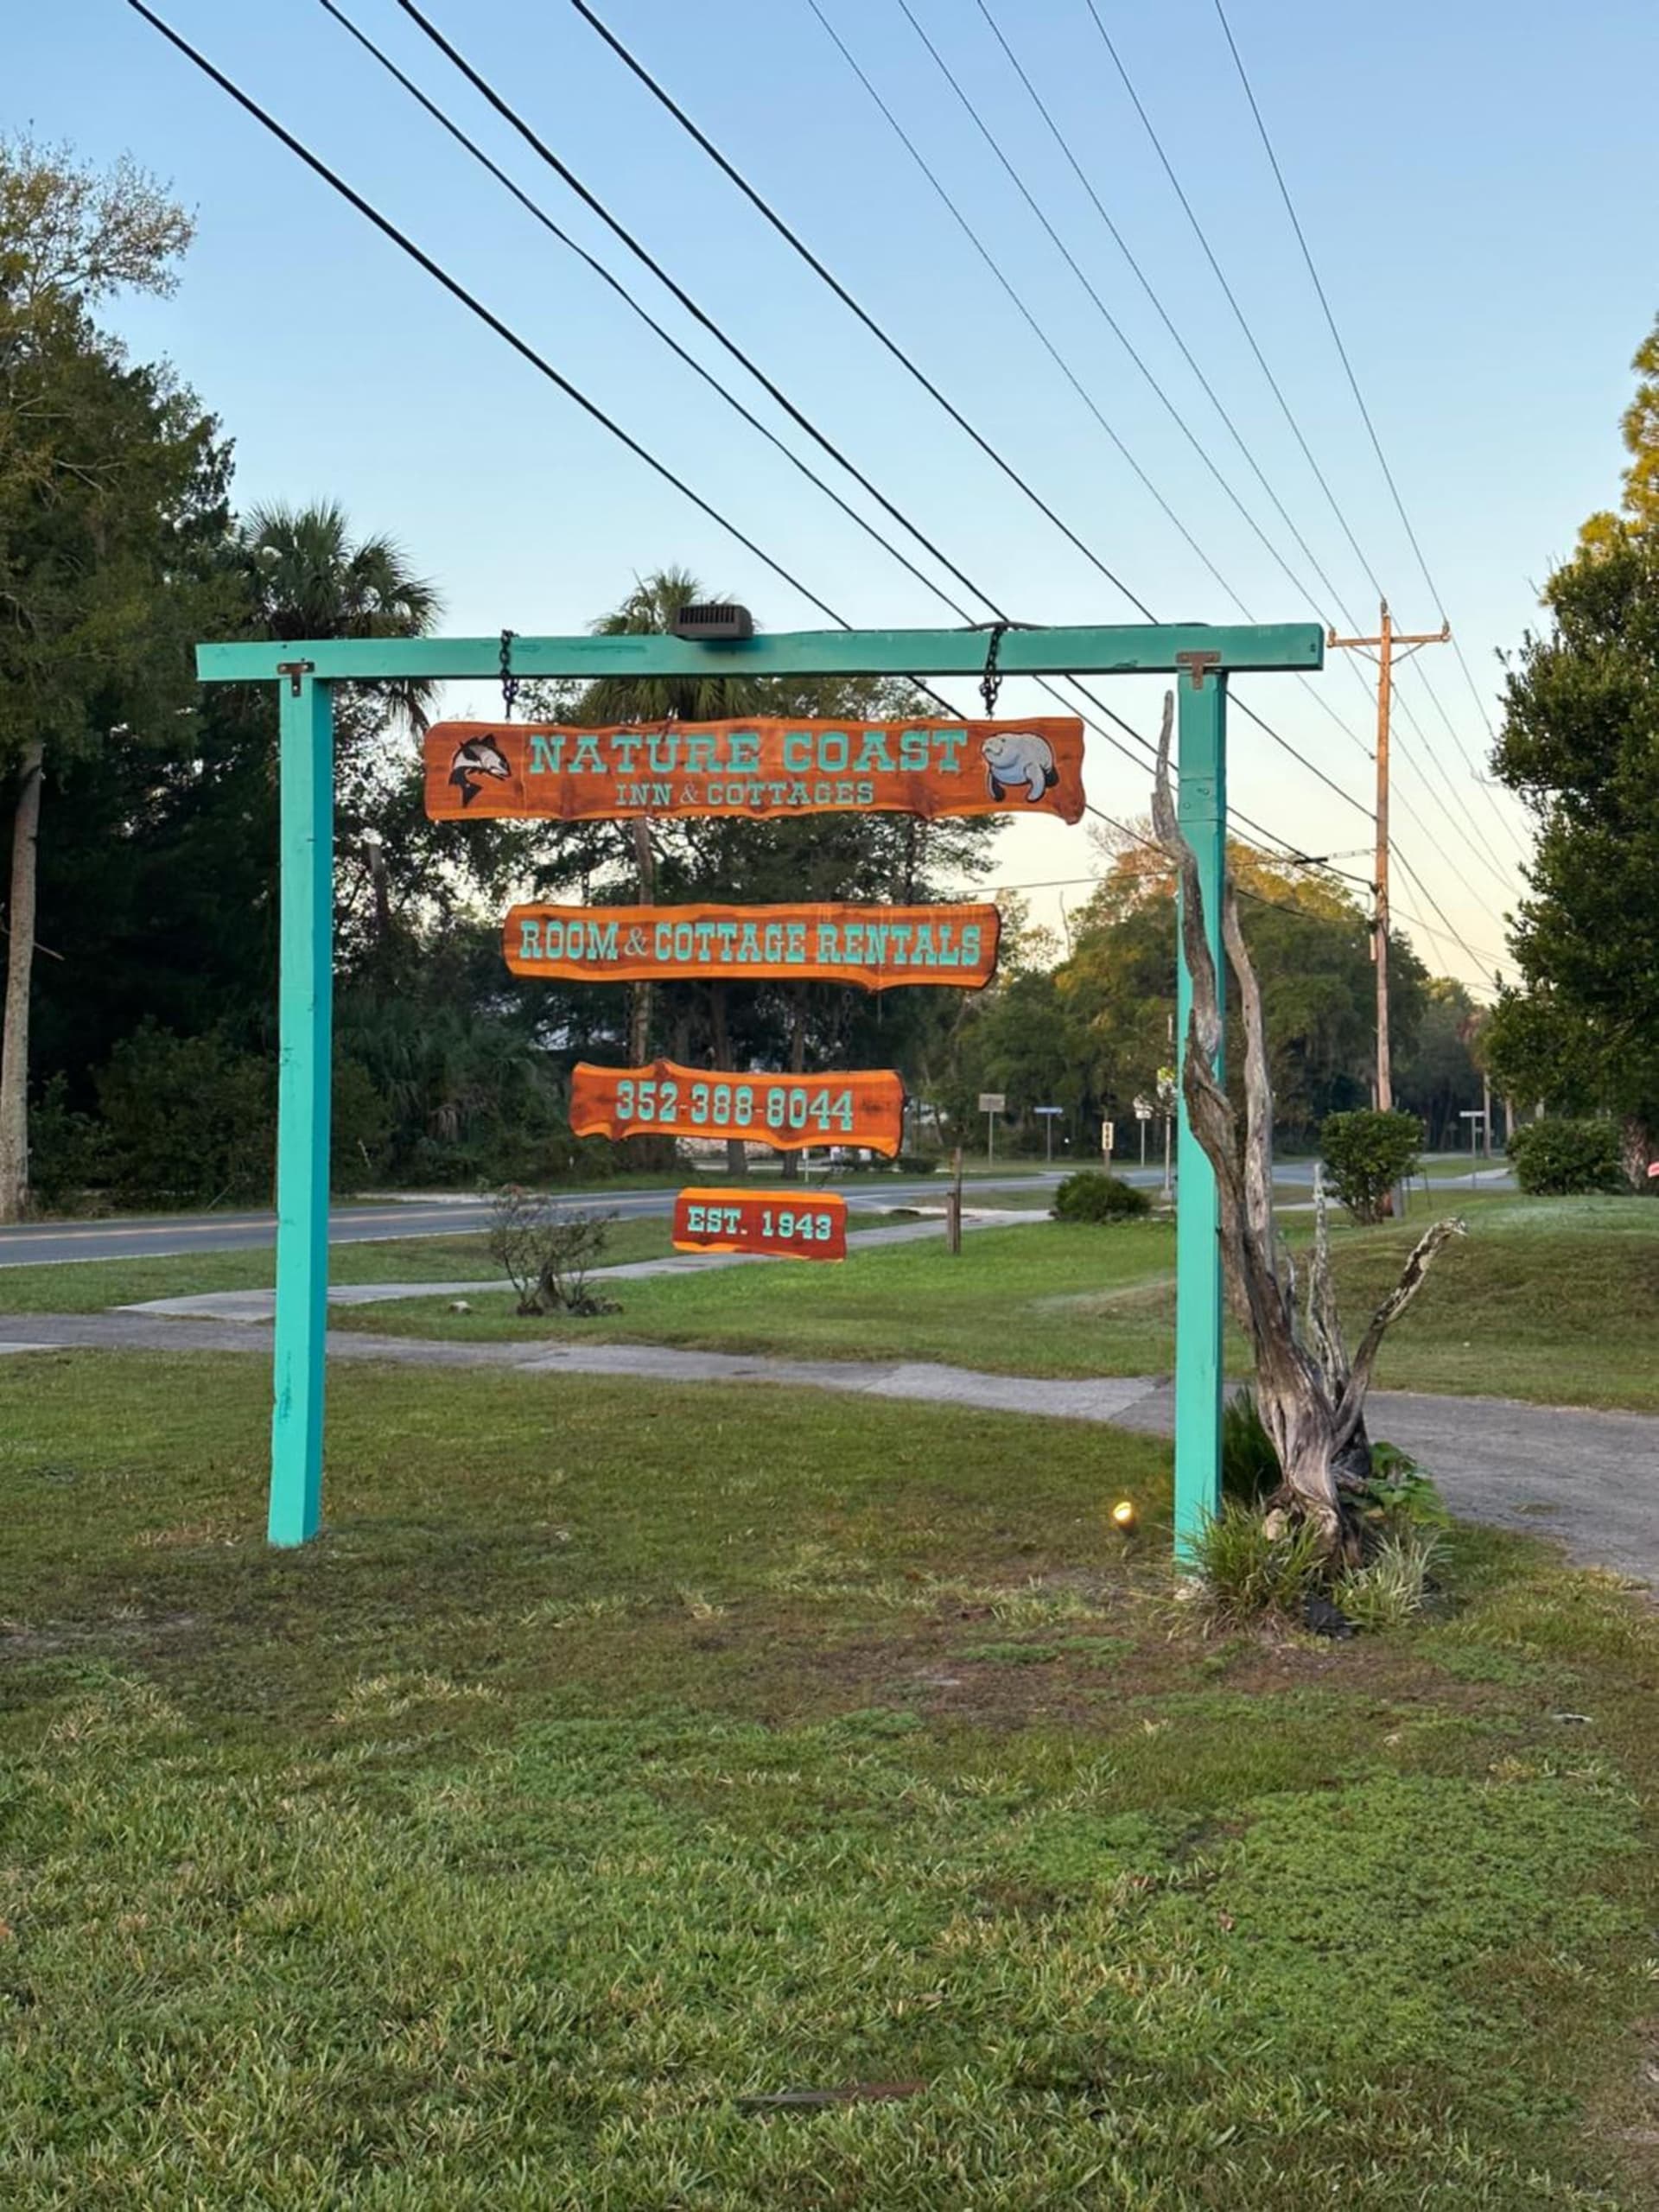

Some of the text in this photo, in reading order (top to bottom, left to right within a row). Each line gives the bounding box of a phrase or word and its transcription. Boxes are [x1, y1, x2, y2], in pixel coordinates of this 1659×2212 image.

[529, 729, 969, 774] NATURE COAST
[616, 781, 874, 806] INN & COTTAGES
[519, 919, 981, 966] ROOM & COTTAGE RENTALS
[615, 1079, 854, 1131] 352-388-8044
[687, 1205, 832, 1241] EST. 1943
